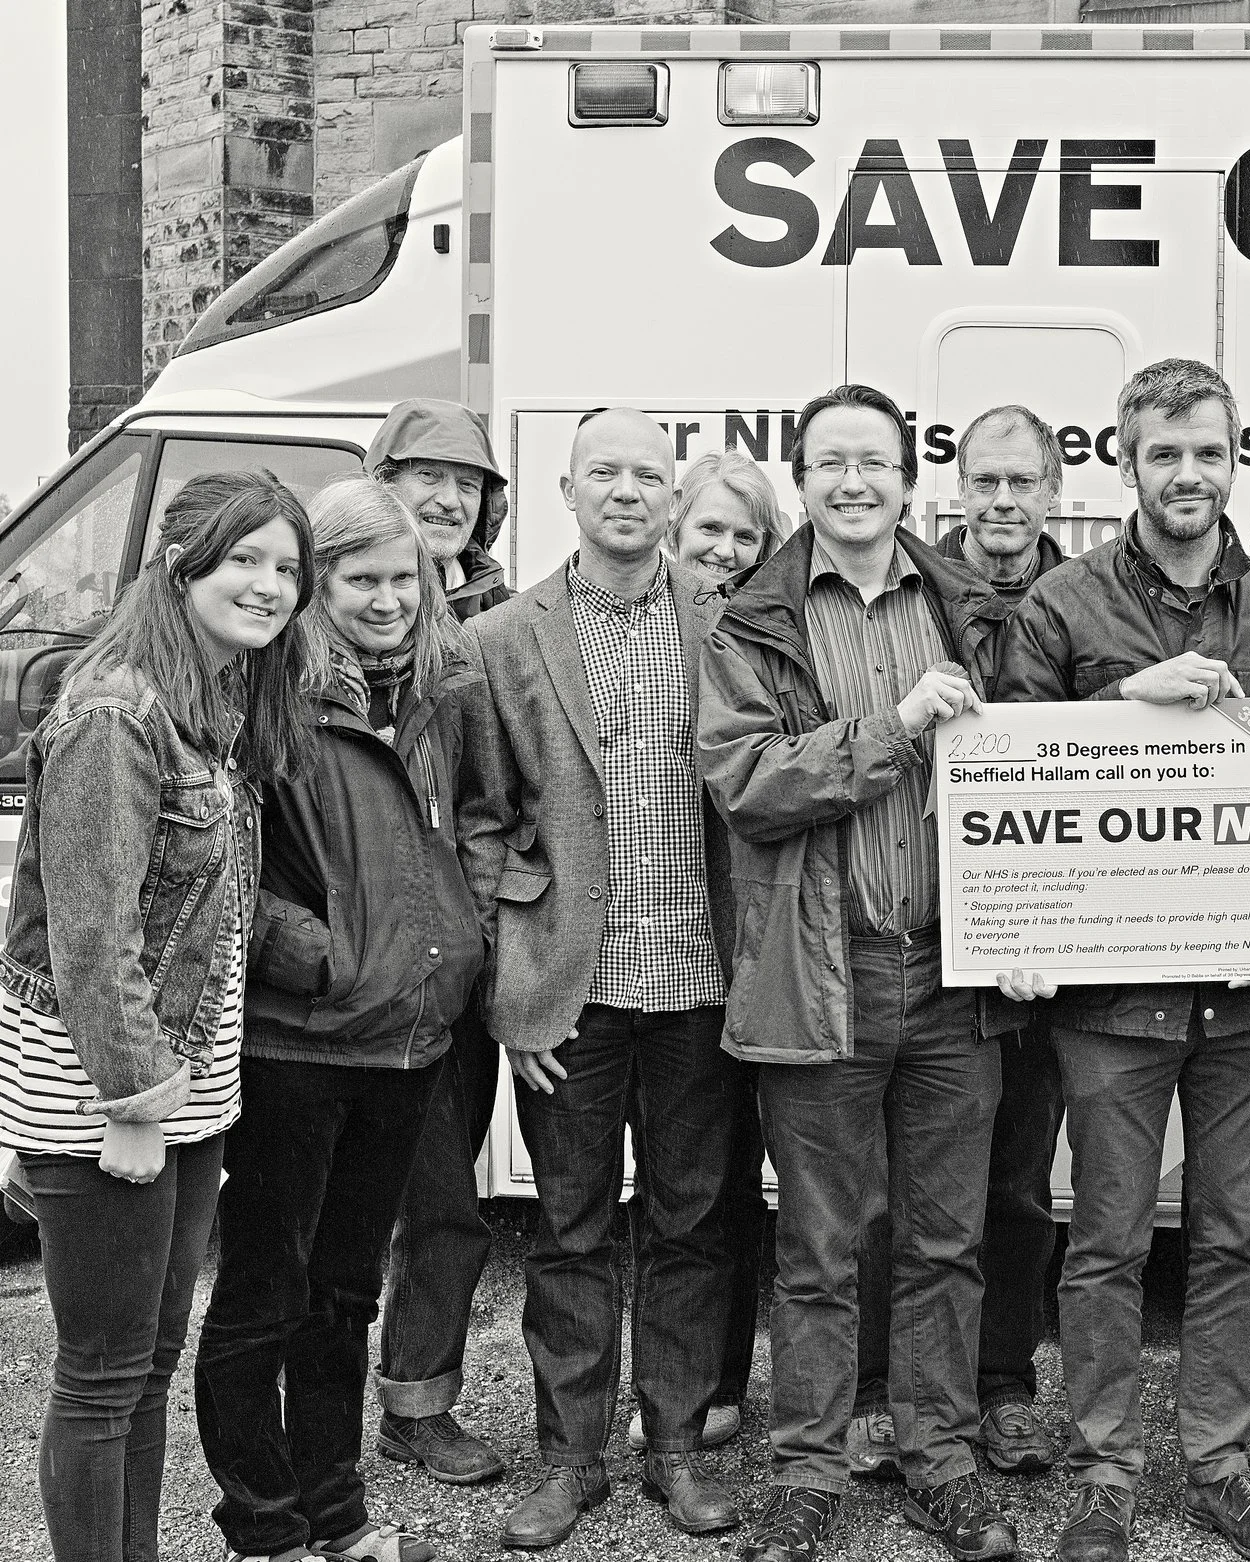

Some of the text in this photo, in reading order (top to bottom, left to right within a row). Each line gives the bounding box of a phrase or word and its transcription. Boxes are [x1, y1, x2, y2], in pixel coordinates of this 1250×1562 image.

[709, 137, 1160, 268] SAVE
[947, 732, 1012, 760] 2,200
[1037, 738, 1246, 761] 38 Degrees members in
[949, 764, 1215, 784] Sheffield Hallam call on you to:
[961, 809, 1083, 846] SAVE
[1098, 806, 1203, 844] OUR
[962, 870, 981, 880] Our
[984, 869, 1009, 879] NHS
[1011, 869, 1019, 879] is
[1021, 869, 1065, 881] precious.
[1068, 868, 1076, 878] If
[1110, 867, 1145, 877] elected
[1148, 867, 1159, 875] as
[1162, 867, 1178, 875] our
[1180, 865, 1200, 876] MP,
[1203, 865, 1234, 876] please
[1237, 864, 1250, 874] do
[962, 882, 1089, 895] can to protect it, including:
[970, 900, 1073, 912] Stopping privatisation
[970, 917, 1005, 928] Making
[1008, 918, 1029, 926] sure
[1032, 916, 1038, 925] it
[1041, 916, 1057, 925] has
[1060, 915, 1075, 925] the
[1077, 915, 1114, 927] funding
[1116, 914, 1122, 924] it
[1125, 913, 1154, 923] needs
[1157, 913, 1165, 923] to
[1168, 912, 1204, 925] provide
[1207, 912, 1228, 924] high
[963, 931, 1020, 942] to everyone
[971, 945, 1021, 957] Protecting
[1023, 945, 1030, 955] it
[1032, 945, 1055, 955] from
[1058, 944, 1073, 954] US
[1076, 943, 1105, 954] health
[1107, 942, 1167, 955] corporations
[1170, 942, 1181, 953] by
[1184, 941, 1222, 952] keeping
[1224, 940, 1239, 950] the
